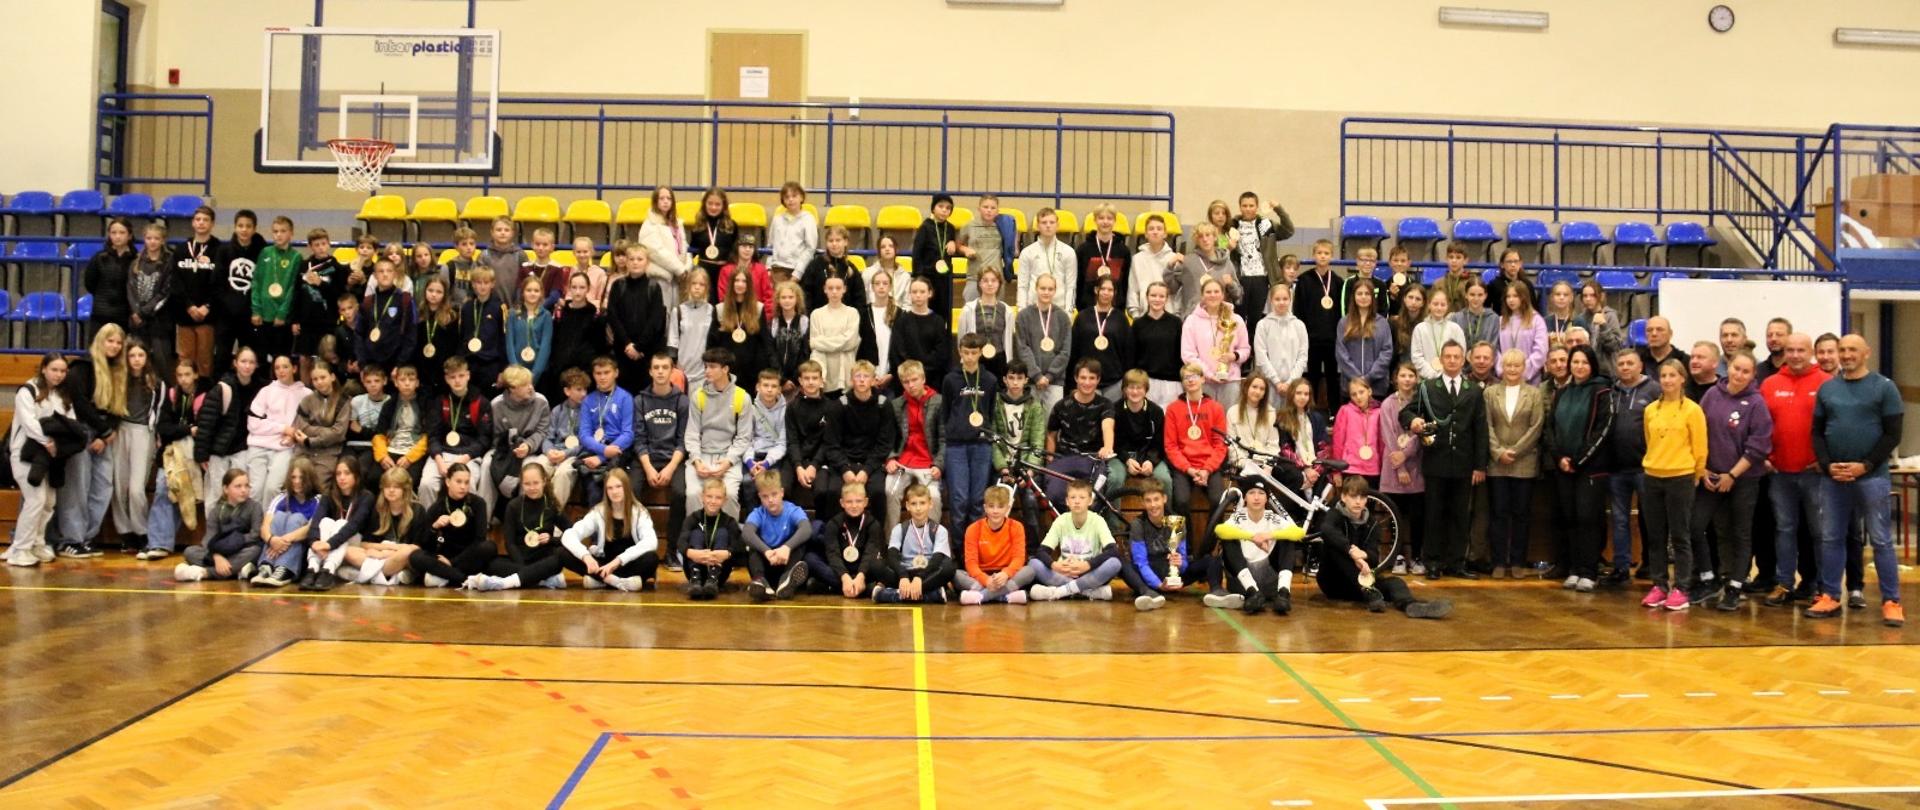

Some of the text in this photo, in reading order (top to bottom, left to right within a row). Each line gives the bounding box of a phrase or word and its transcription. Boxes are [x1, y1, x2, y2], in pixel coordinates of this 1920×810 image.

[177, 257, 216, 271] ellsse
[644, 408, 662, 422] NOT
[653, 417, 672, 425] SALE
